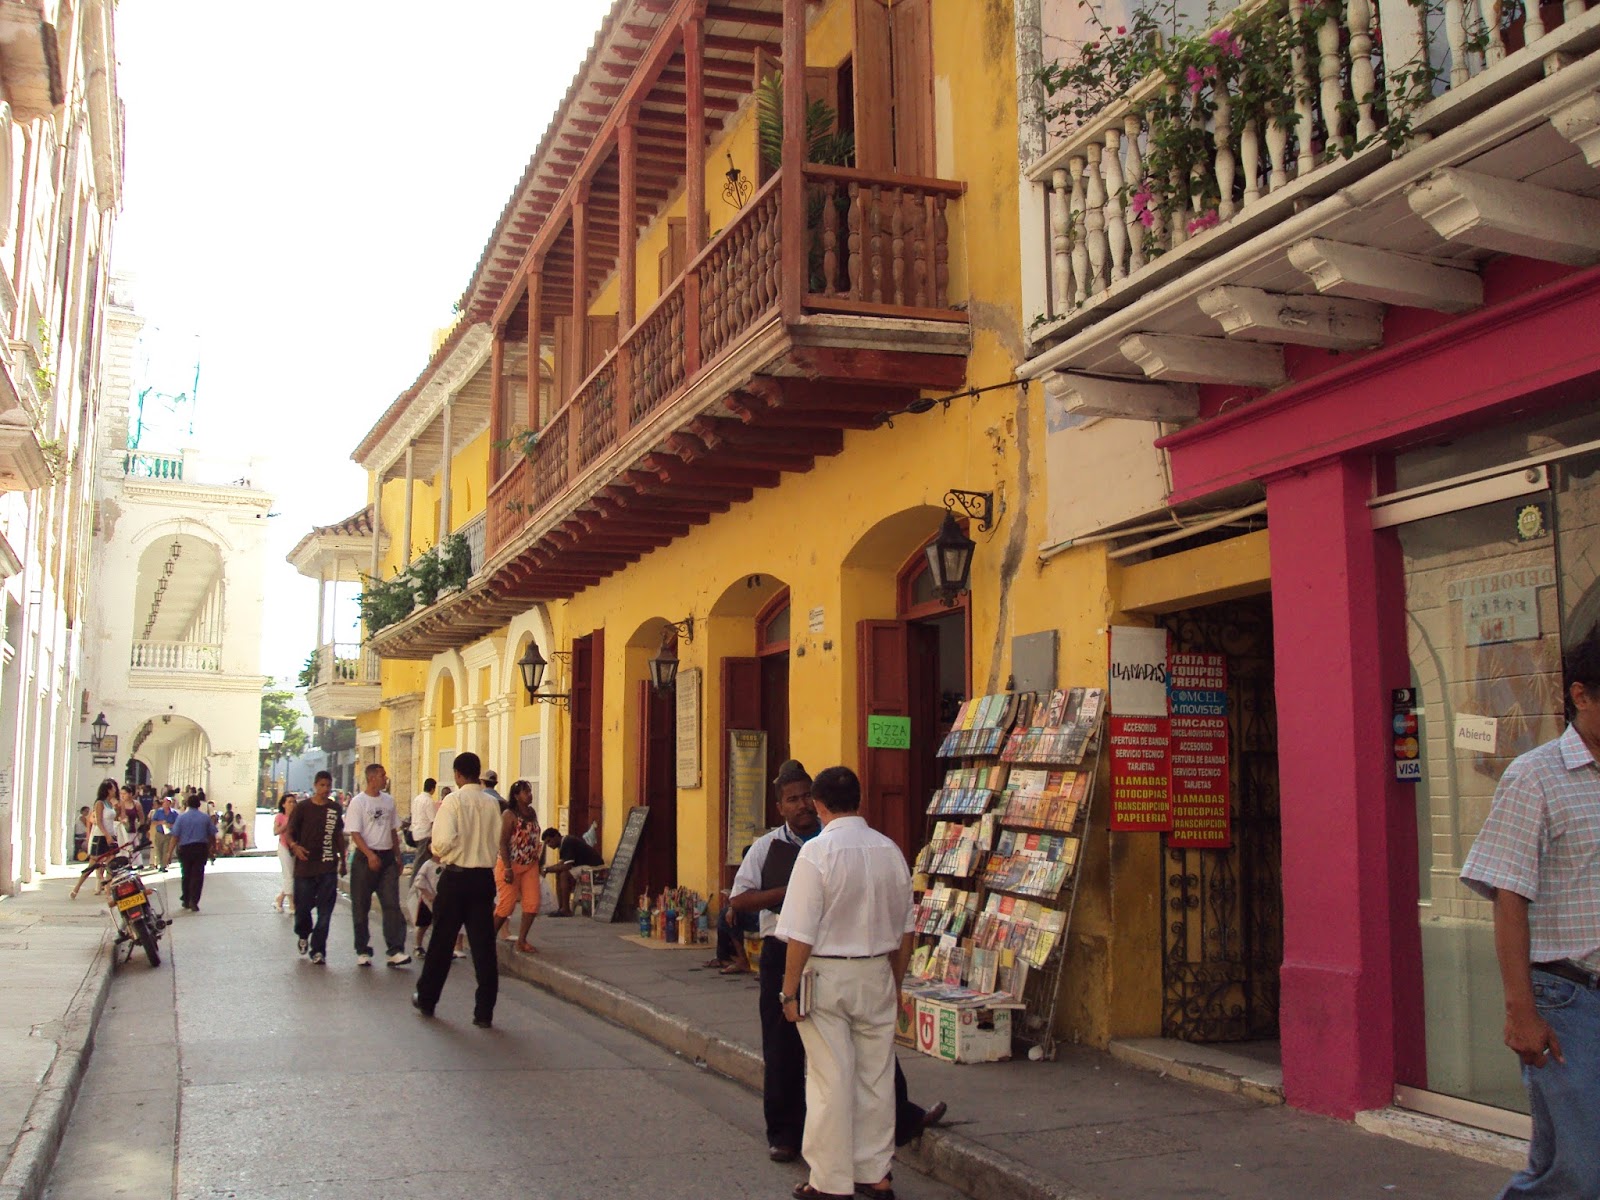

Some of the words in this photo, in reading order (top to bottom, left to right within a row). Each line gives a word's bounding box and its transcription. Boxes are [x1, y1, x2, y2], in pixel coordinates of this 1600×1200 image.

[1208, 656, 1222, 666] DE
[1112, 662, 1166, 684] LLAMADAS
[1172, 666, 1223, 677] EQUIPOS
[1171, 678, 1222, 688] PREPAGO
[1171, 690, 1220, 702] COMCEL
[1123, 722, 1156, 732] ACCESORIOS
[1171, 718, 1224, 728] SIMCARD
[1458, 727, 1492, 742] Abierto
[1111, 737, 1139, 745] APERTURA
[1180, 742, 1213, 751] ACCESORIOS
[1116, 750, 1140, 758] SERVICIO
[1142, 750, 1164, 758] TECNICO
[1172, 755, 1196, 764] PERTURA
[1128, 762, 1155, 771] TARJETAS
[1398, 764, 1420, 774] VISA
[1173, 768, 1196, 776] SERVICIO
[1198, 768, 1220, 776] TECNICO
[1115, 776, 1168, 786] LLAMADAS
[1184, 780, 1212, 789] TARJETAS
[1116, 790, 1168, 798] FOTOCOPIAS
[1173, 794, 1225, 804] LLAMADAS
[1114, 802, 1170, 810] TRANSCRIPCION
[1174, 807, 1224, 816] FOTOCOPIAS
[1117, 813, 1167, 822] PAPELERIA
[322, 808, 338, 862] AEROPOSTALE
[1174, 830, 1224, 840] PAPELERIA
